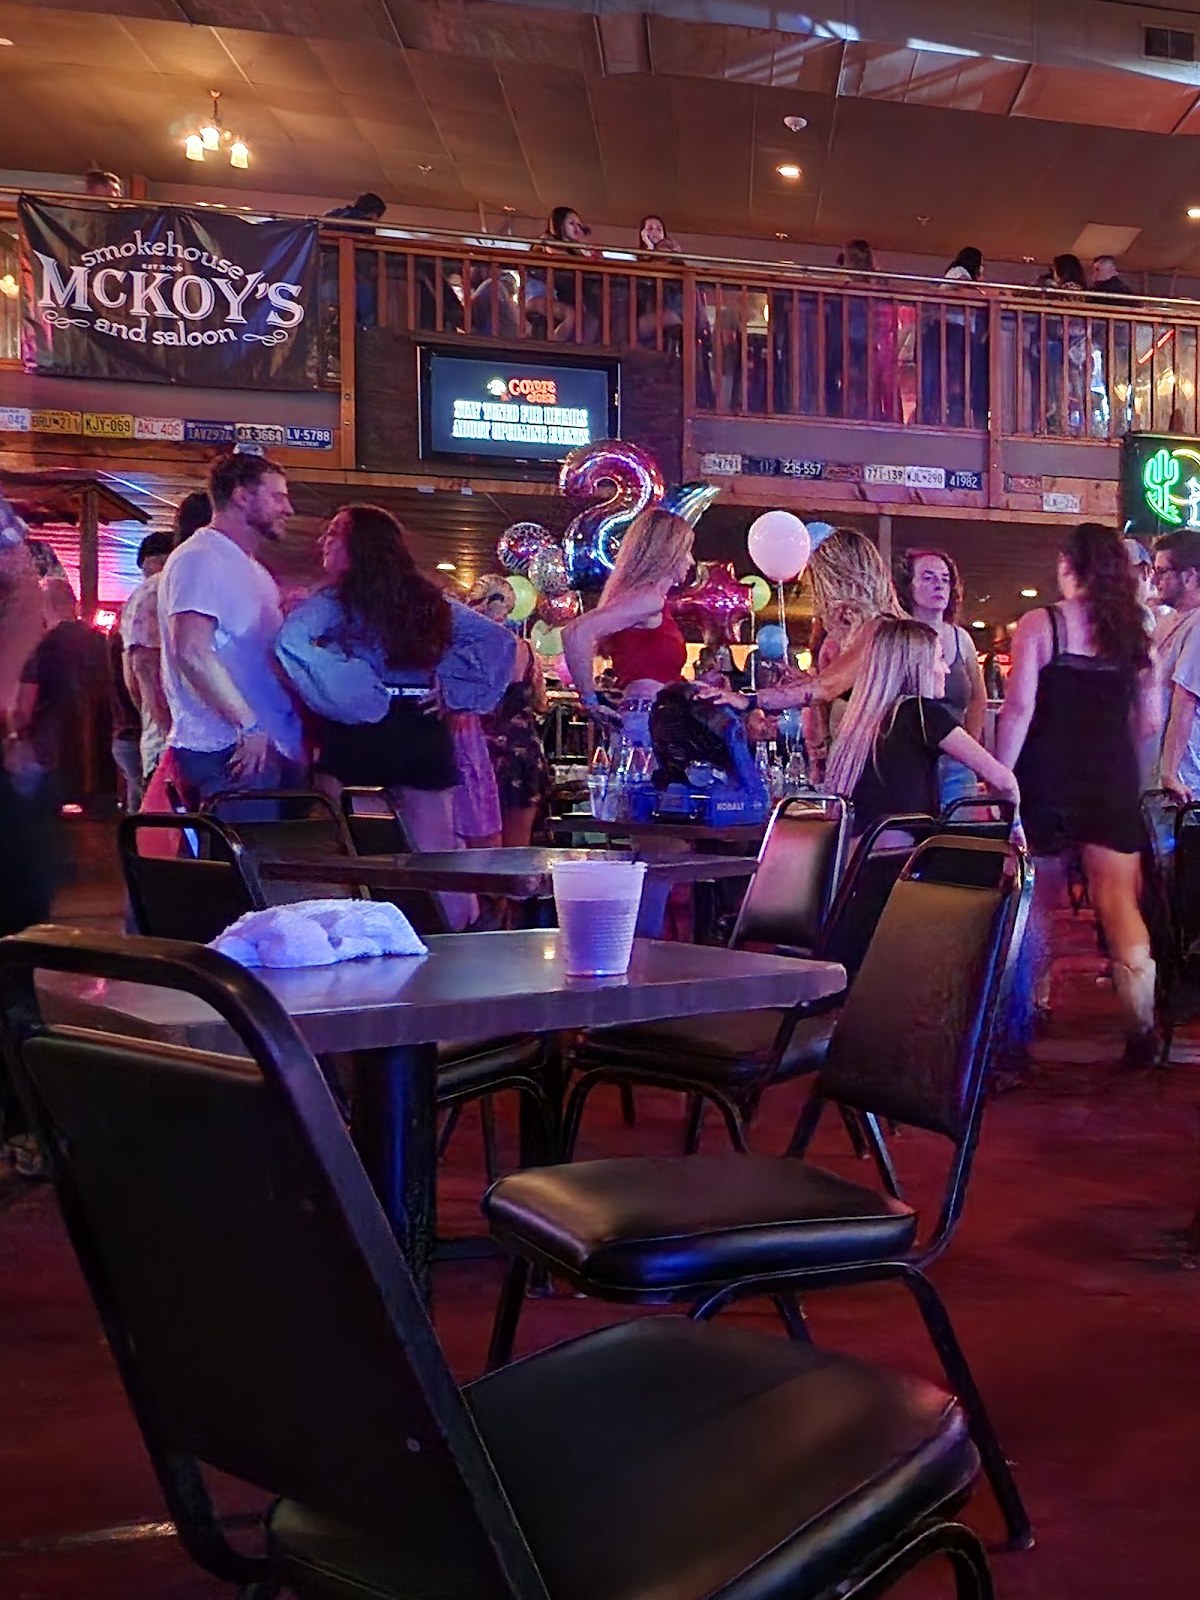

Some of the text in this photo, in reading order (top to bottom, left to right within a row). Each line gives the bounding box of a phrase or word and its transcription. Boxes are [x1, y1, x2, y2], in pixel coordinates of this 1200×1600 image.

[81, 230, 244, 280] smokehouse
[159, 264, 183, 272] 2006
[33, 249, 305, 328] MCKOY'S
[94, 318, 238, 347] and saloon
